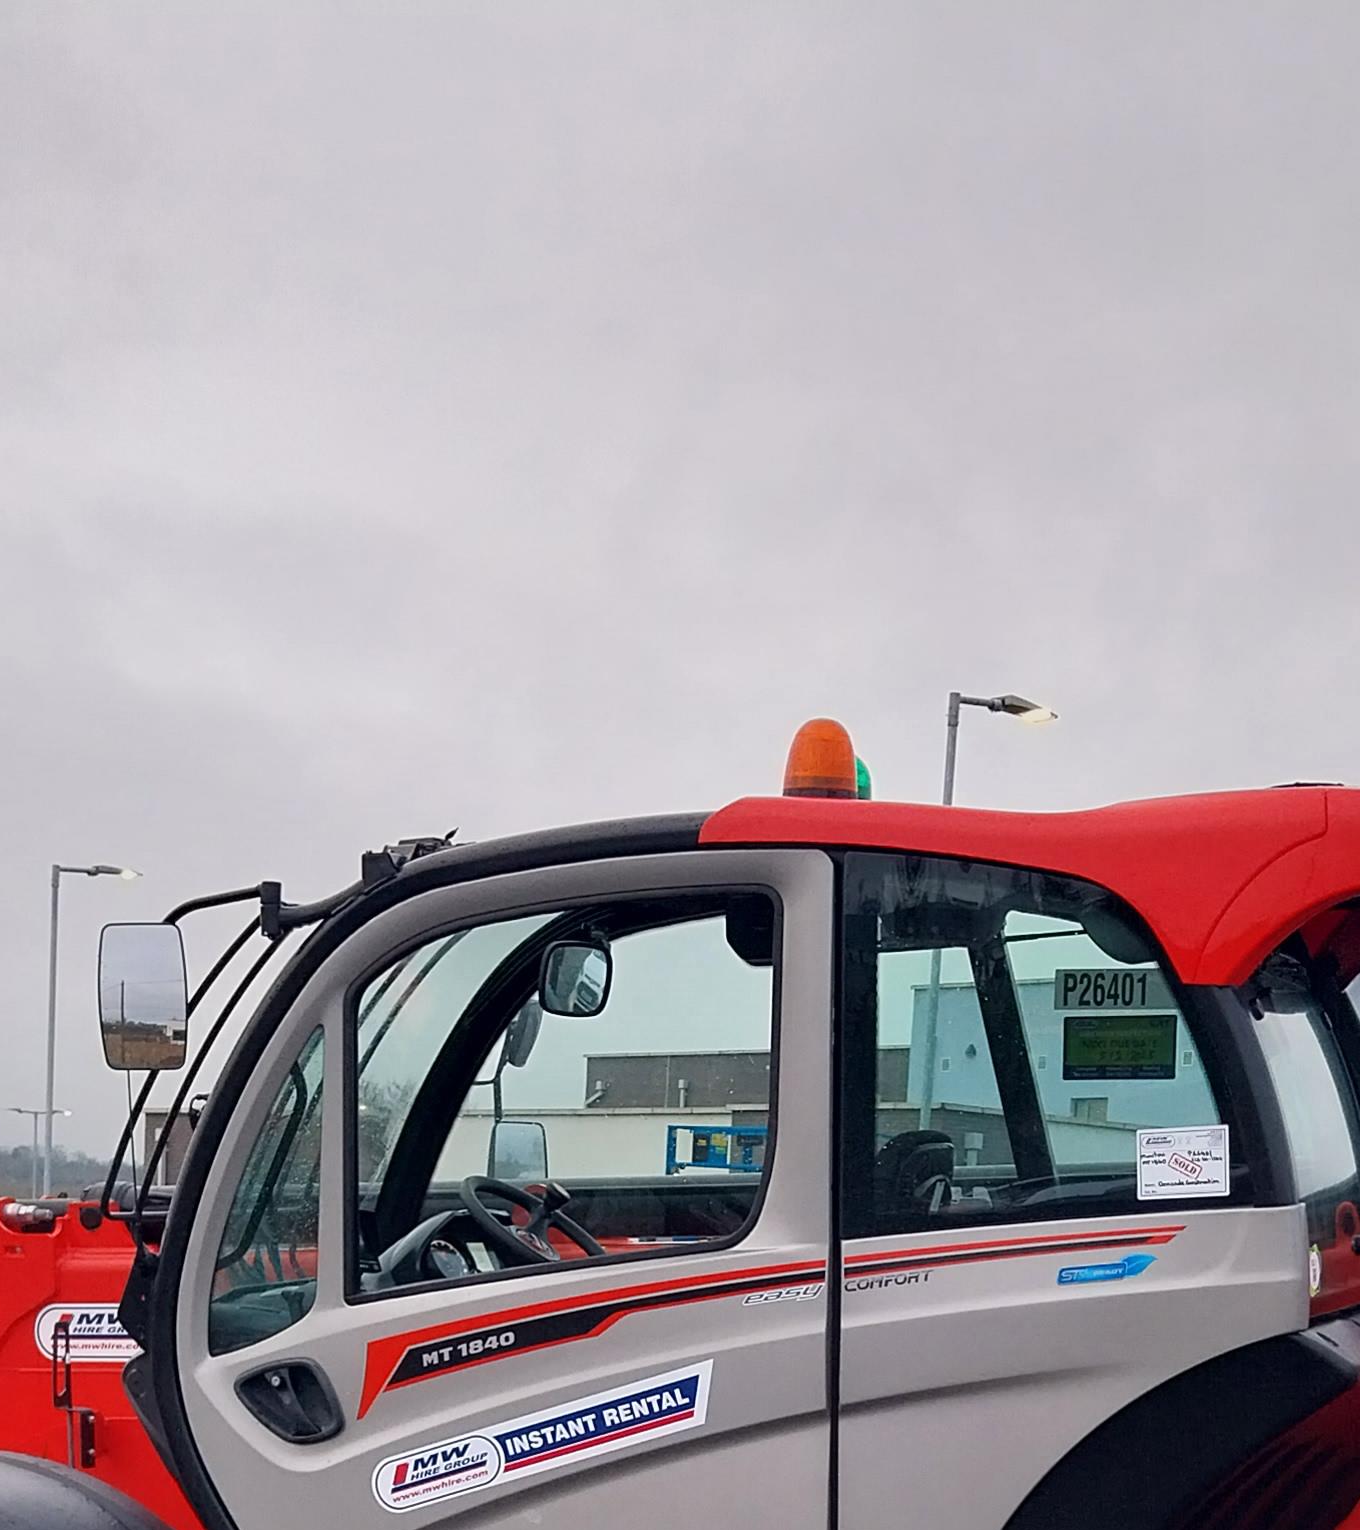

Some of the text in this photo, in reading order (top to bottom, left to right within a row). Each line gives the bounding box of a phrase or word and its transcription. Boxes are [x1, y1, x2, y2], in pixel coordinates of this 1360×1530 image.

[1063, 973, 1147, 1007] P26401
[1172, 1157, 1197, 1175] SOLD
[743, 1269, 934, 1305] easy COMFORT
[421, 1331, 516, 1368] MT 1840
[504, 1386, 691, 1457] INSTANT RENTAL
[410, 1451, 490, 1482] HIRE GROUP
[411, 1442, 471, 1472] MW
[392, 1468, 490, 1502] www.mwhire.com
